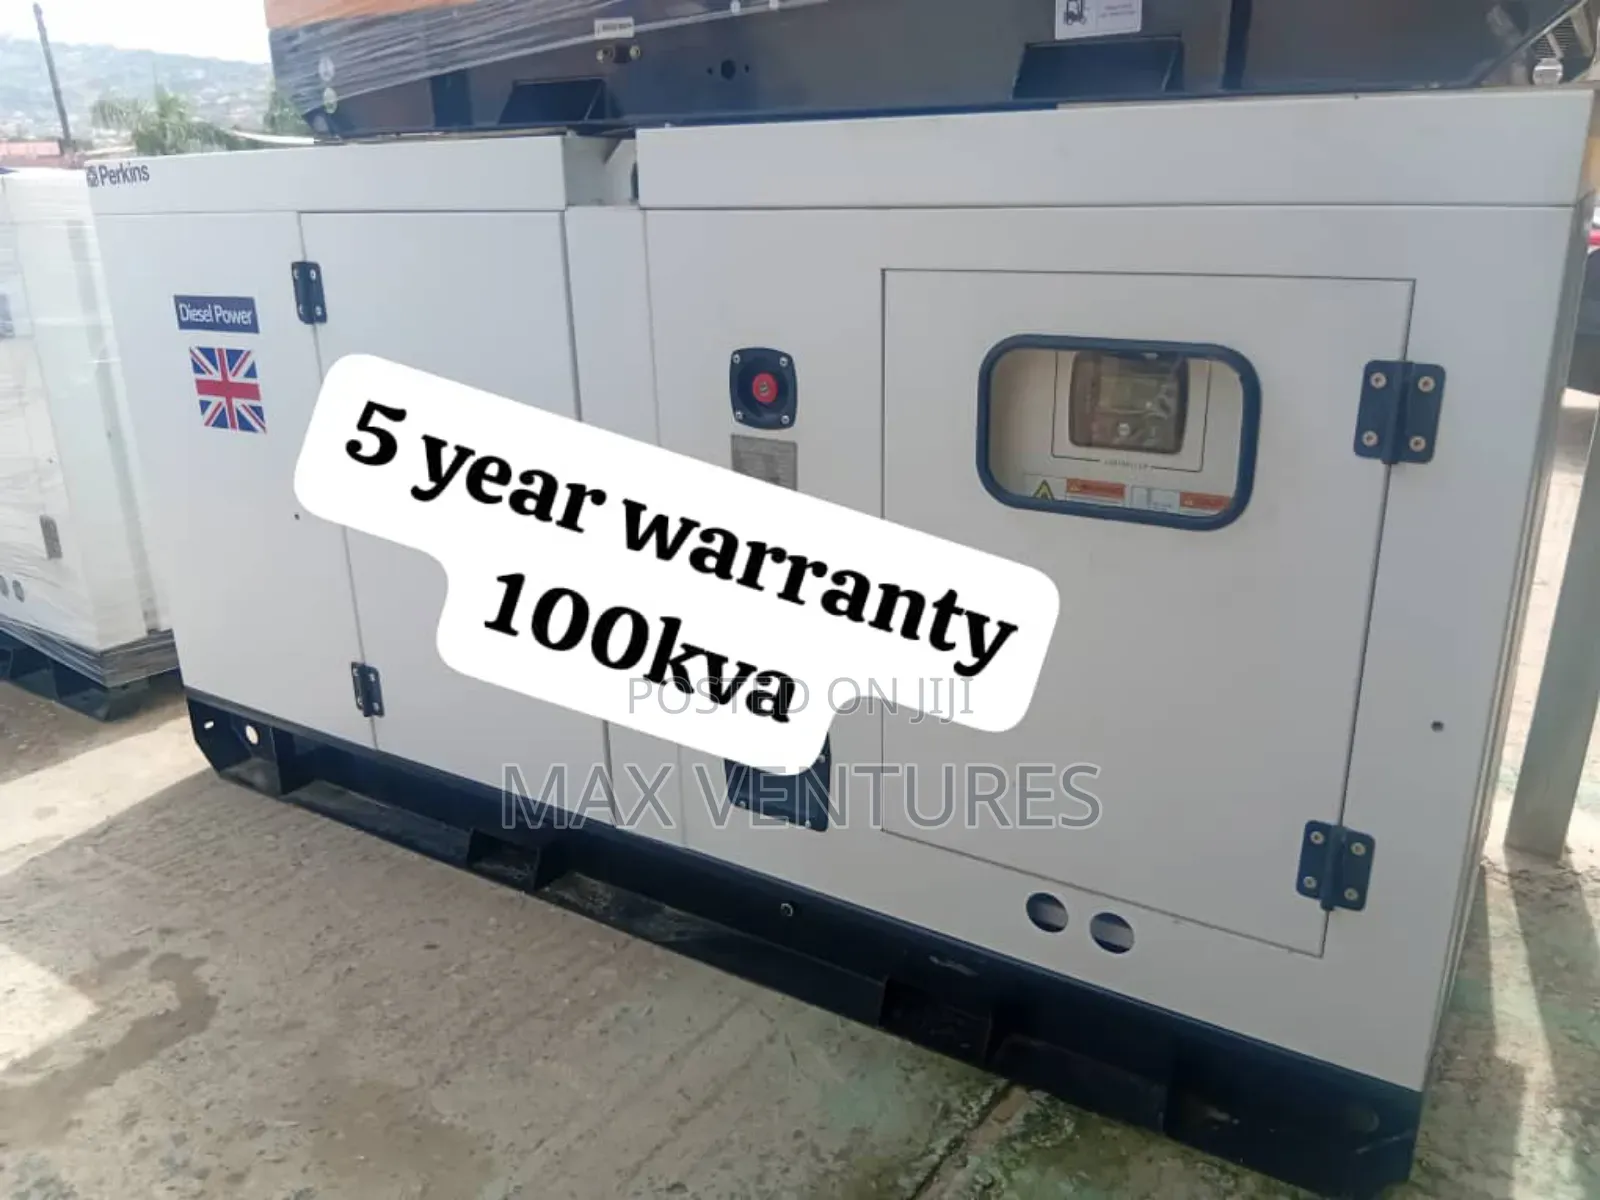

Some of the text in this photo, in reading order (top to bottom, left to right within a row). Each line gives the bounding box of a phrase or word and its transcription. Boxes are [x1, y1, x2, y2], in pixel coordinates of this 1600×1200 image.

[98, 161, 150, 187] Perkins
[179, 303, 253, 326] Diesel Power
